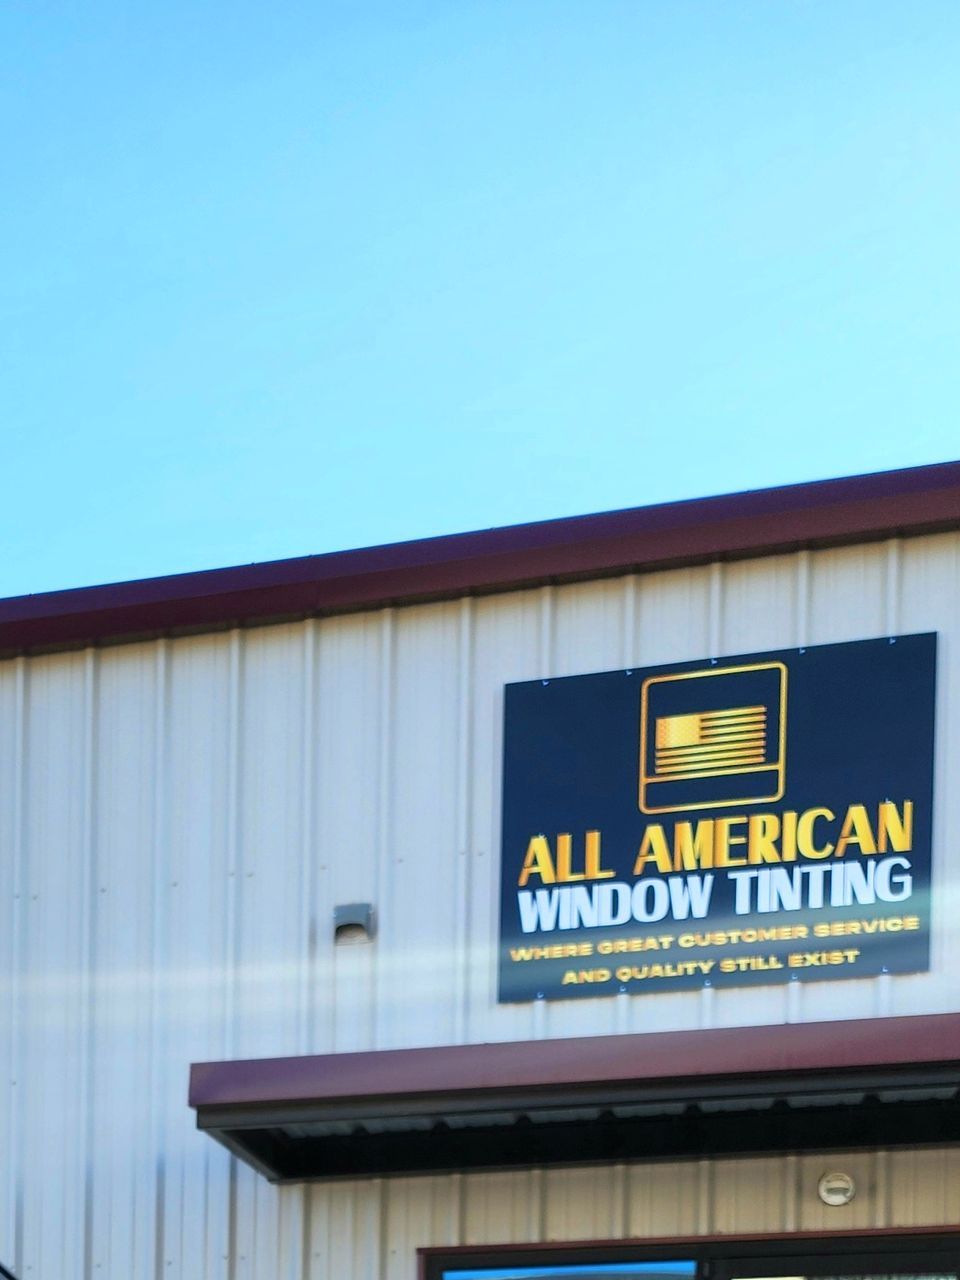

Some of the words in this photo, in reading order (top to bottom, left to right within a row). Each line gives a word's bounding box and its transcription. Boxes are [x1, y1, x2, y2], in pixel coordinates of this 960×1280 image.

[518, 830, 615, 886] ALL
[633, 800, 914, 875] AMERICAN
[517, 873, 714, 933] WINDOW
[727, 856, 914, 915] TINTING
[509, 942, 594, 962] WHERE
[596, 935, 675, 956] GREAT
[677, 925, 809, 949] CUSTOMER
[812, 916, 921, 939] SERVICE
[561, 968, 613, 986] AND
[615, 960, 716, 983] QUALITY
[719, 953, 784, 974] STILL
[787, 948, 861, 968] EXIST
